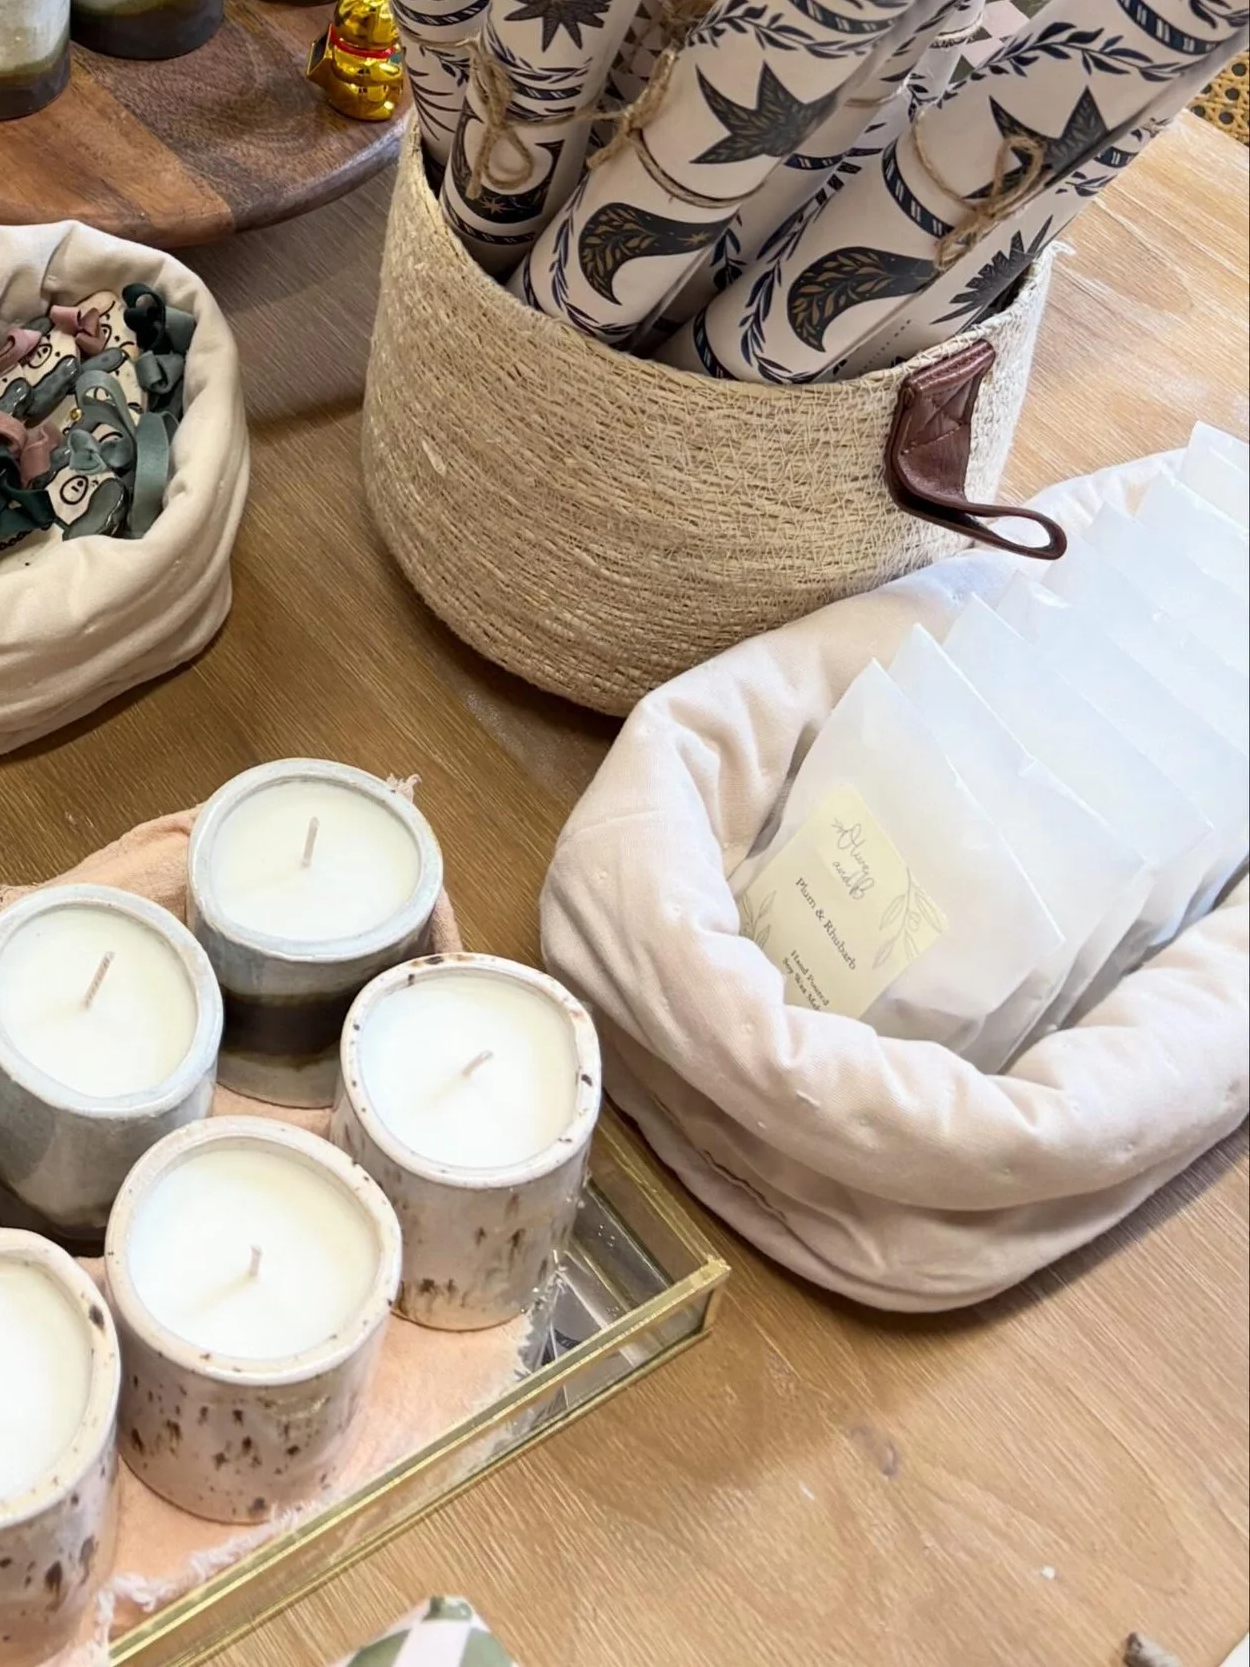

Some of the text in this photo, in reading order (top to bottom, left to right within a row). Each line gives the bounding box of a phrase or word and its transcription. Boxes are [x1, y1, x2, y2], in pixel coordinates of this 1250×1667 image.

[795, 877, 857, 970] Plum & Rhubarb
